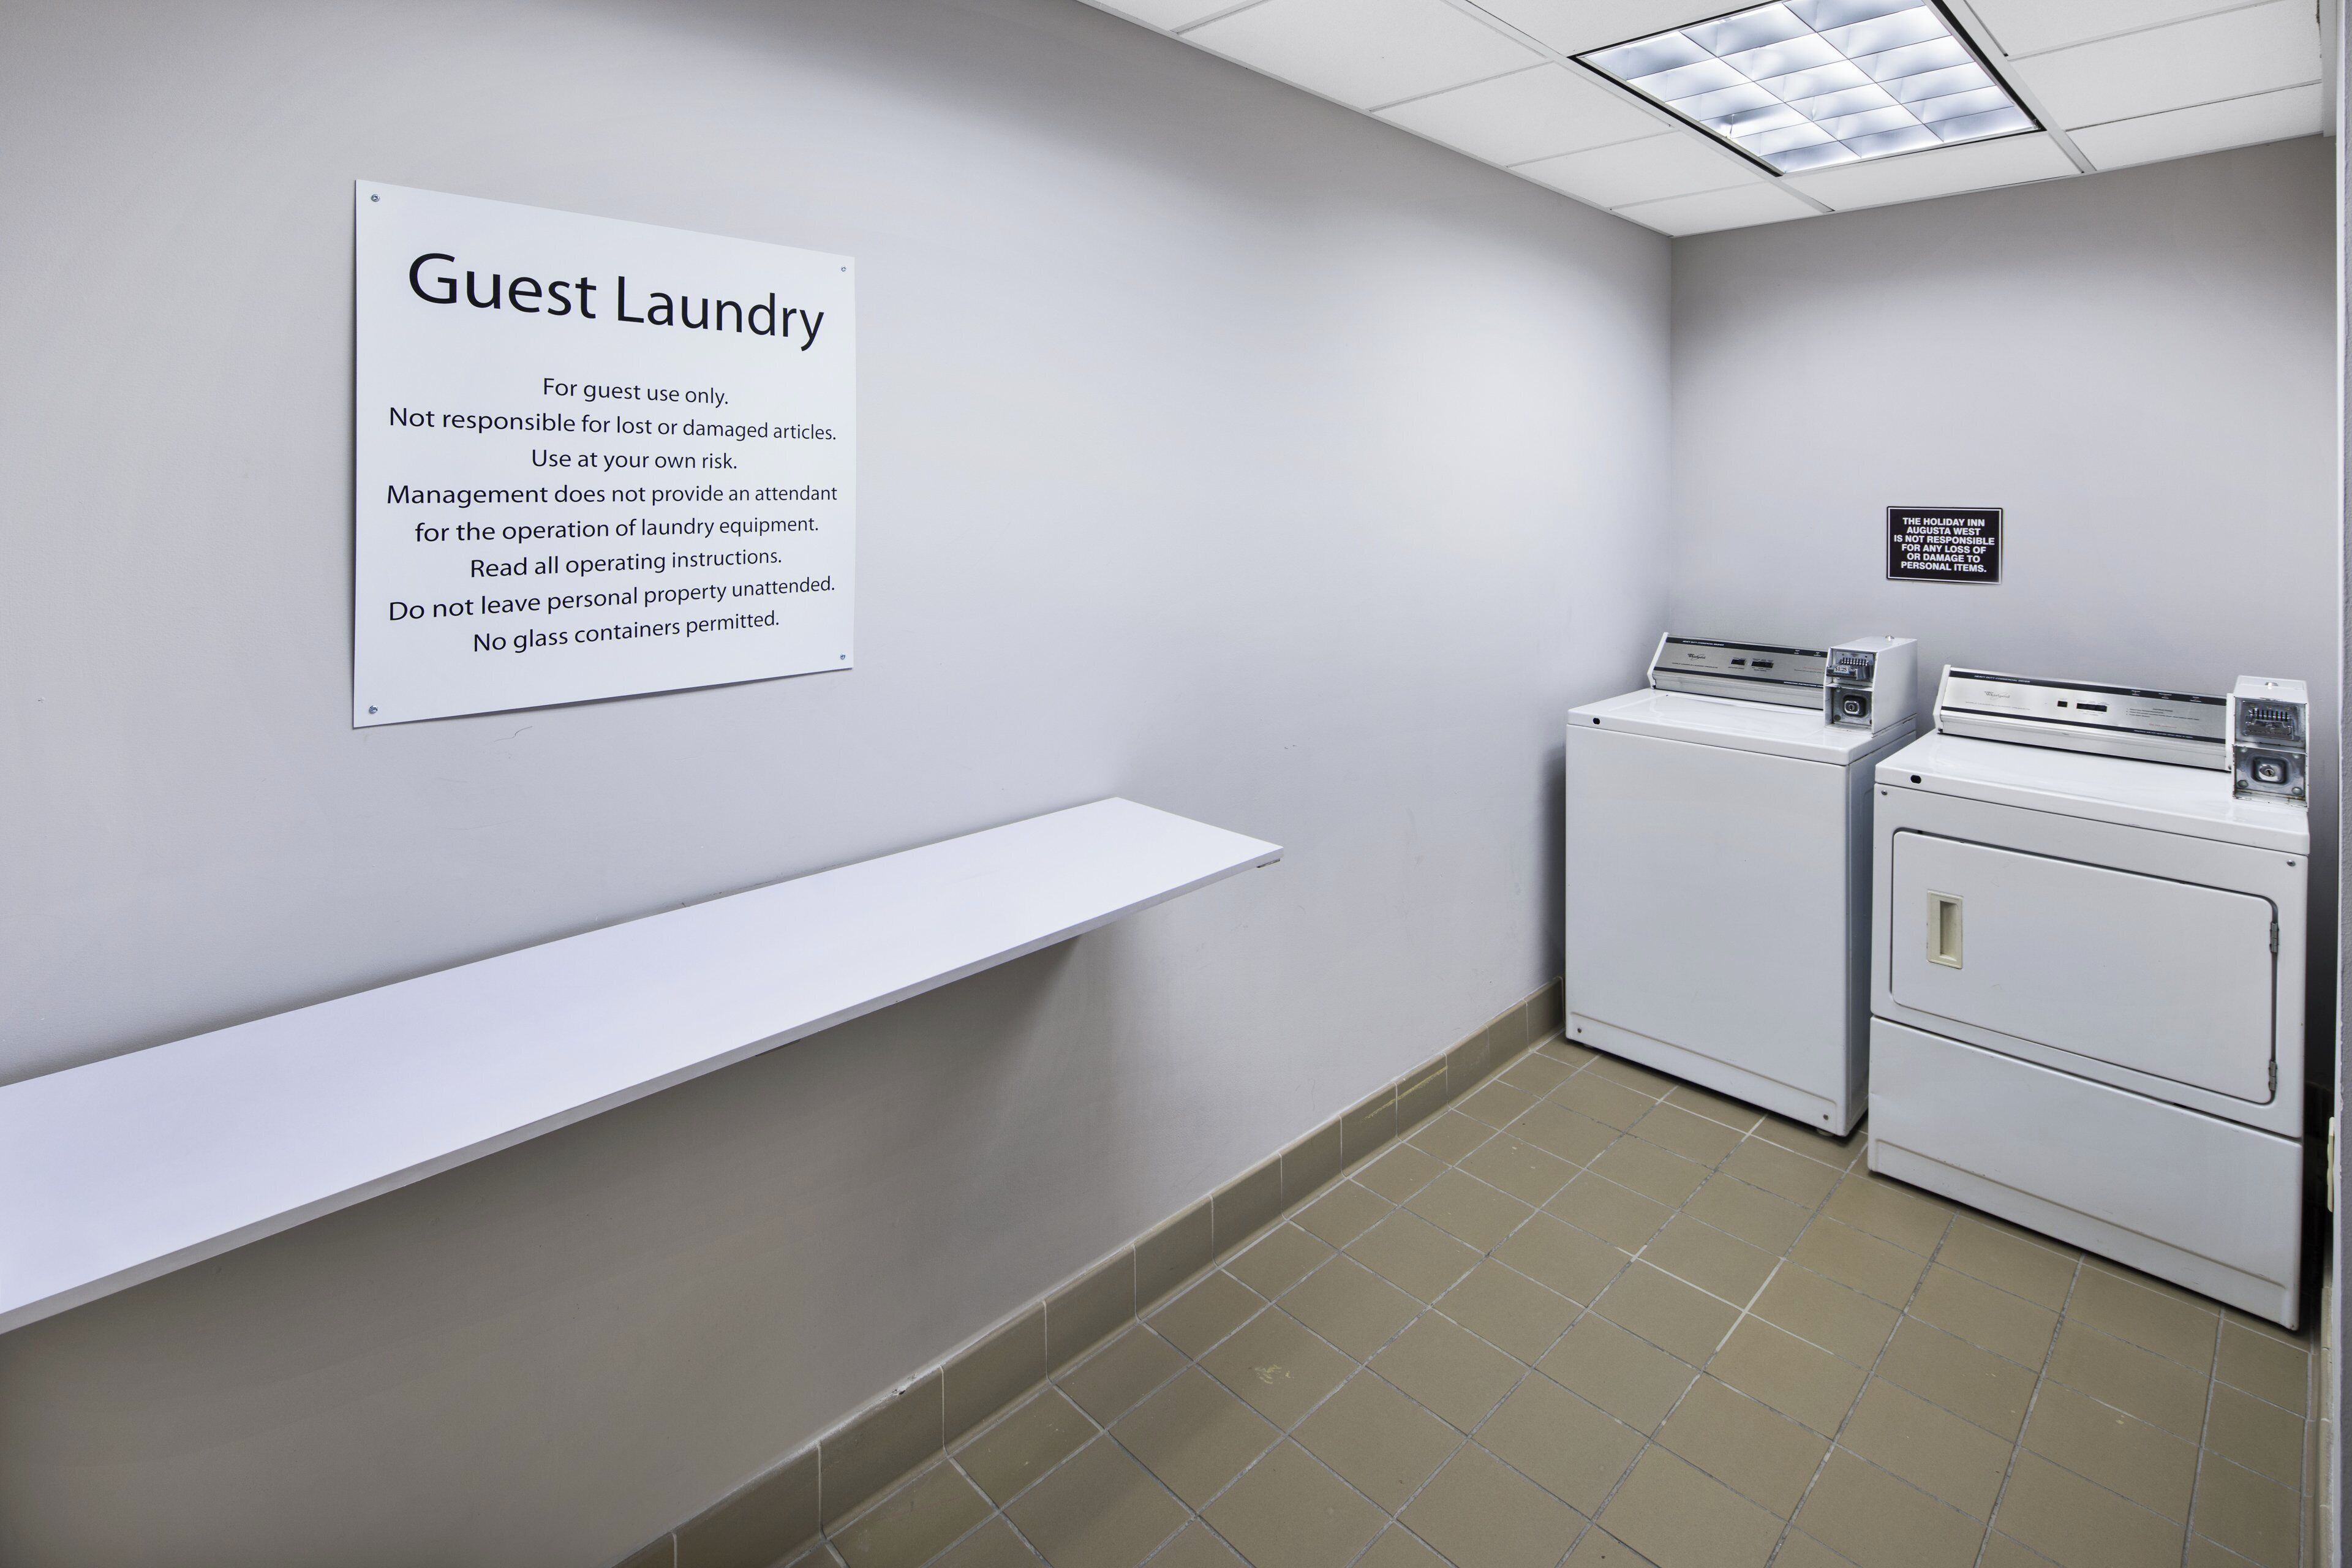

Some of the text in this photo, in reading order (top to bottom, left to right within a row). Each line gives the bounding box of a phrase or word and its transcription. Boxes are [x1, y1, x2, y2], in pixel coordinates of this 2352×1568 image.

[409, 252, 824, 352] Guest Laundry
[544, 377, 728, 409] For guest use only.
[390, 407, 836, 442] Not responsible for lost or damaged articles.
[532, 449, 737, 472] Use at your own risk.
[387, 484, 837, 508] Management does not provide an attendant
[415, 517, 818, 544] for the operation of laundry equipment.
[1926, 536, 1994, 545] RESPONSIBLE
[471, 549, 782, 578] Read all operating instructions.
[1901, 561, 1951, 570] PERSONAL
[390, 575, 835, 621] Do not leave personal property unattended.
[474, 609, 779, 654] No glass containers permitted.
